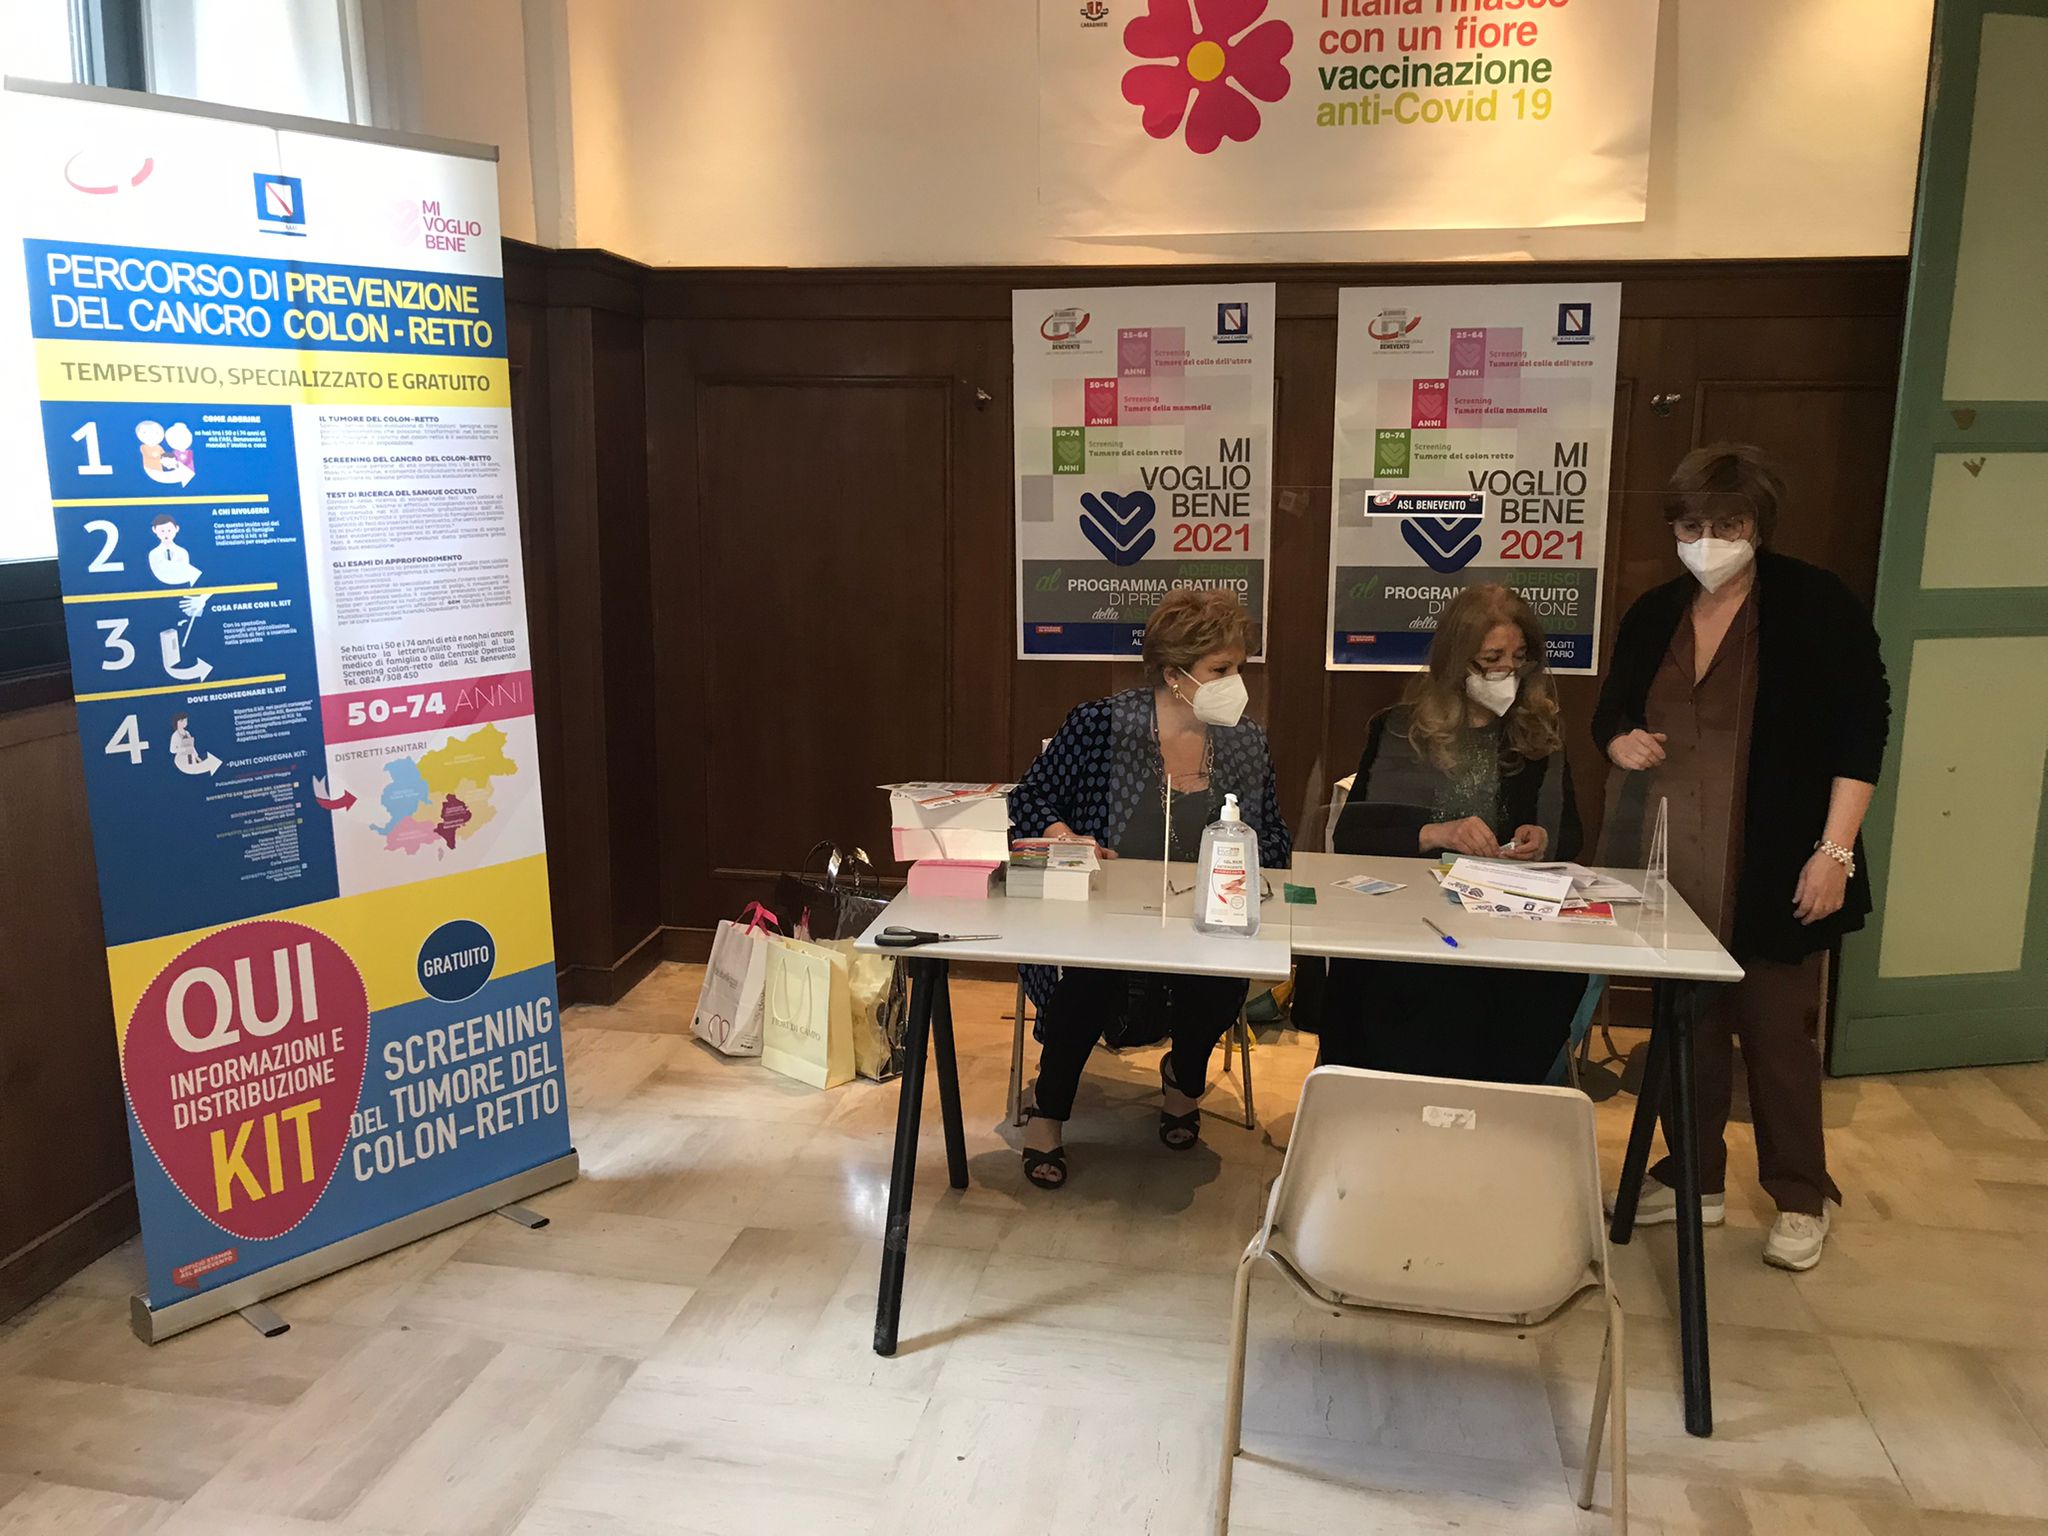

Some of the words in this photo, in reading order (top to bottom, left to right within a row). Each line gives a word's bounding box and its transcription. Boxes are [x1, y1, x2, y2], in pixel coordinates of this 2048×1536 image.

[1319, 28, 1384, 54] con
[1398, 25, 1441, 51] un
[1455, 16, 1538, 49] fiore
[1318, 53, 1552, 90] vaccinazione
[1316, 89, 1497, 127] anti-Covid
[1511, 88, 1552, 120] 19
[422, 200, 440, 216] MI
[423, 216, 481, 237] VOGLIO
[425, 234, 466, 252] BENE
[47, 252, 243, 299] PERCORSO
[249, 268, 280, 301] DI
[285, 271, 480, 314] PREVENZIONE
[51, 294, 124, 330] DEL
[128, 298, 271, 338] CANCRO
[284, 309, 389, 343] COLON
[408, 316, 493, 348] RETTO
[60, 362, 224, 388] TEMPESTIVO,
[229, 367, 383, 389] SPECIALIZZATO
[388, 373, 399, 389] E
[402, 373, 490, 391] GRATUITO
[71, 421, 113, 475] 1
[1219, 438, 1250, 462] MI
[1414, 443, 1452, 451] Screening
[1449, 452, 1464, 460] del
[1465, 452, 1489, 460] colon
[1554, 442, 1588, 468] MI
[323, 456, 371, 464] SCREENING
[1140, 465, 1250, 491] VOGLIO
[1468, 470, 1587, 496] VOGLIO
[326, 491, 346, 499] TEST
[1172, 493, 1250, 517] BENE
[1397, 500, 1414, 510] ASL
[1416, 500, 1467, 510] BENEVENTO
[1500, 499, 1585, 524] BENE
[83, 520, 125, 573] 2
[1173, 523, 1250, 552] 2021
[1500, 530, 1583, 560] 2021
[348, 559, 373, 567] ESAMI
[385, 554, 463, 566] APPROFONDIMENTO
[1179, 564, 1248, 577] ADERISCI
[1068, 579, 1168, 592] PROGRAMMA
[1504, 572, 1580, 585] ADERISCI
[211, 604, 232, 612] COSA
[233, 602, 253, 610] FARE
[253, 601, 270, 609] CON
[279, 599, 291, 607] KIT
[1109, 593, 1125, 606] DI
[1092, 607, 1120, 621] della
[1409, 616, 1438, 629] della
[96, 618, 135, 671] 3
[341, 646, 351, 654] Se
[352, 644, 366, 653] hai
[367, 643, 380, 651] tra
[407, 640, 416, 648] 74
[417, 638, 434, 646] anni
[436, 636, 443, 644] di
[478, 632, 490, 640] hai
[490, 630, 514, 639] ancora
[491, 638, 499, 646] al
[503, 637, 515, 645] tuo
[342, 661, 373, 670] medico
[375, 659, 384, 667] di
[385, 655, 421, 667] famiglia
[429, 652, 445, 661] alla
[447, 648, 479, 659] Centrale
[481, 645, 515, 657] Operativa
[343, 667, 384, 679] Screening
[387, 662, 433, 673] colon-retto
[439, 659, 459, 668] della
[464, 657, 478, 665] ASL
[480, 652, 516, 663] Benevento
[344, 678, 357, 687] Tel.
[359, 674, 381, 685] 0824
[403, 671, 419, 680] 450
[187, 695, 208, 704] DOVE
[210, 688, 266, 701] RICONSEGNARE
[348, 692, 446, 726] 50-74
[454, 681, 523, 712] ANNI
[105, 714, 149, 764] 4
[253, 752, 293, 764] CONSEGNA
[335, 747, 383, 763] DISTRETTI
[385, 741, 427, 755] SANITARI
[423, 945, 490, 978] GRATUITO
[165, 942, 319, 1054] QUI
[383, 996, 552, 1081] SCREENING
[170, 1032, 326, 1100] INFORMAZIONI
[332, 1027, 344, 1052] E
[173, 1058, 336, 1130] DISTRIBUZIONE
[350, 1106, 388, 1139] DEL
[390, 1056, 505, 1123] TUMORE
[511, 1041, 558, 1085] DEL
[352, 1078, 560, 1182] COLON-RETTO
[210, 1098, 322, 1213] KIT
